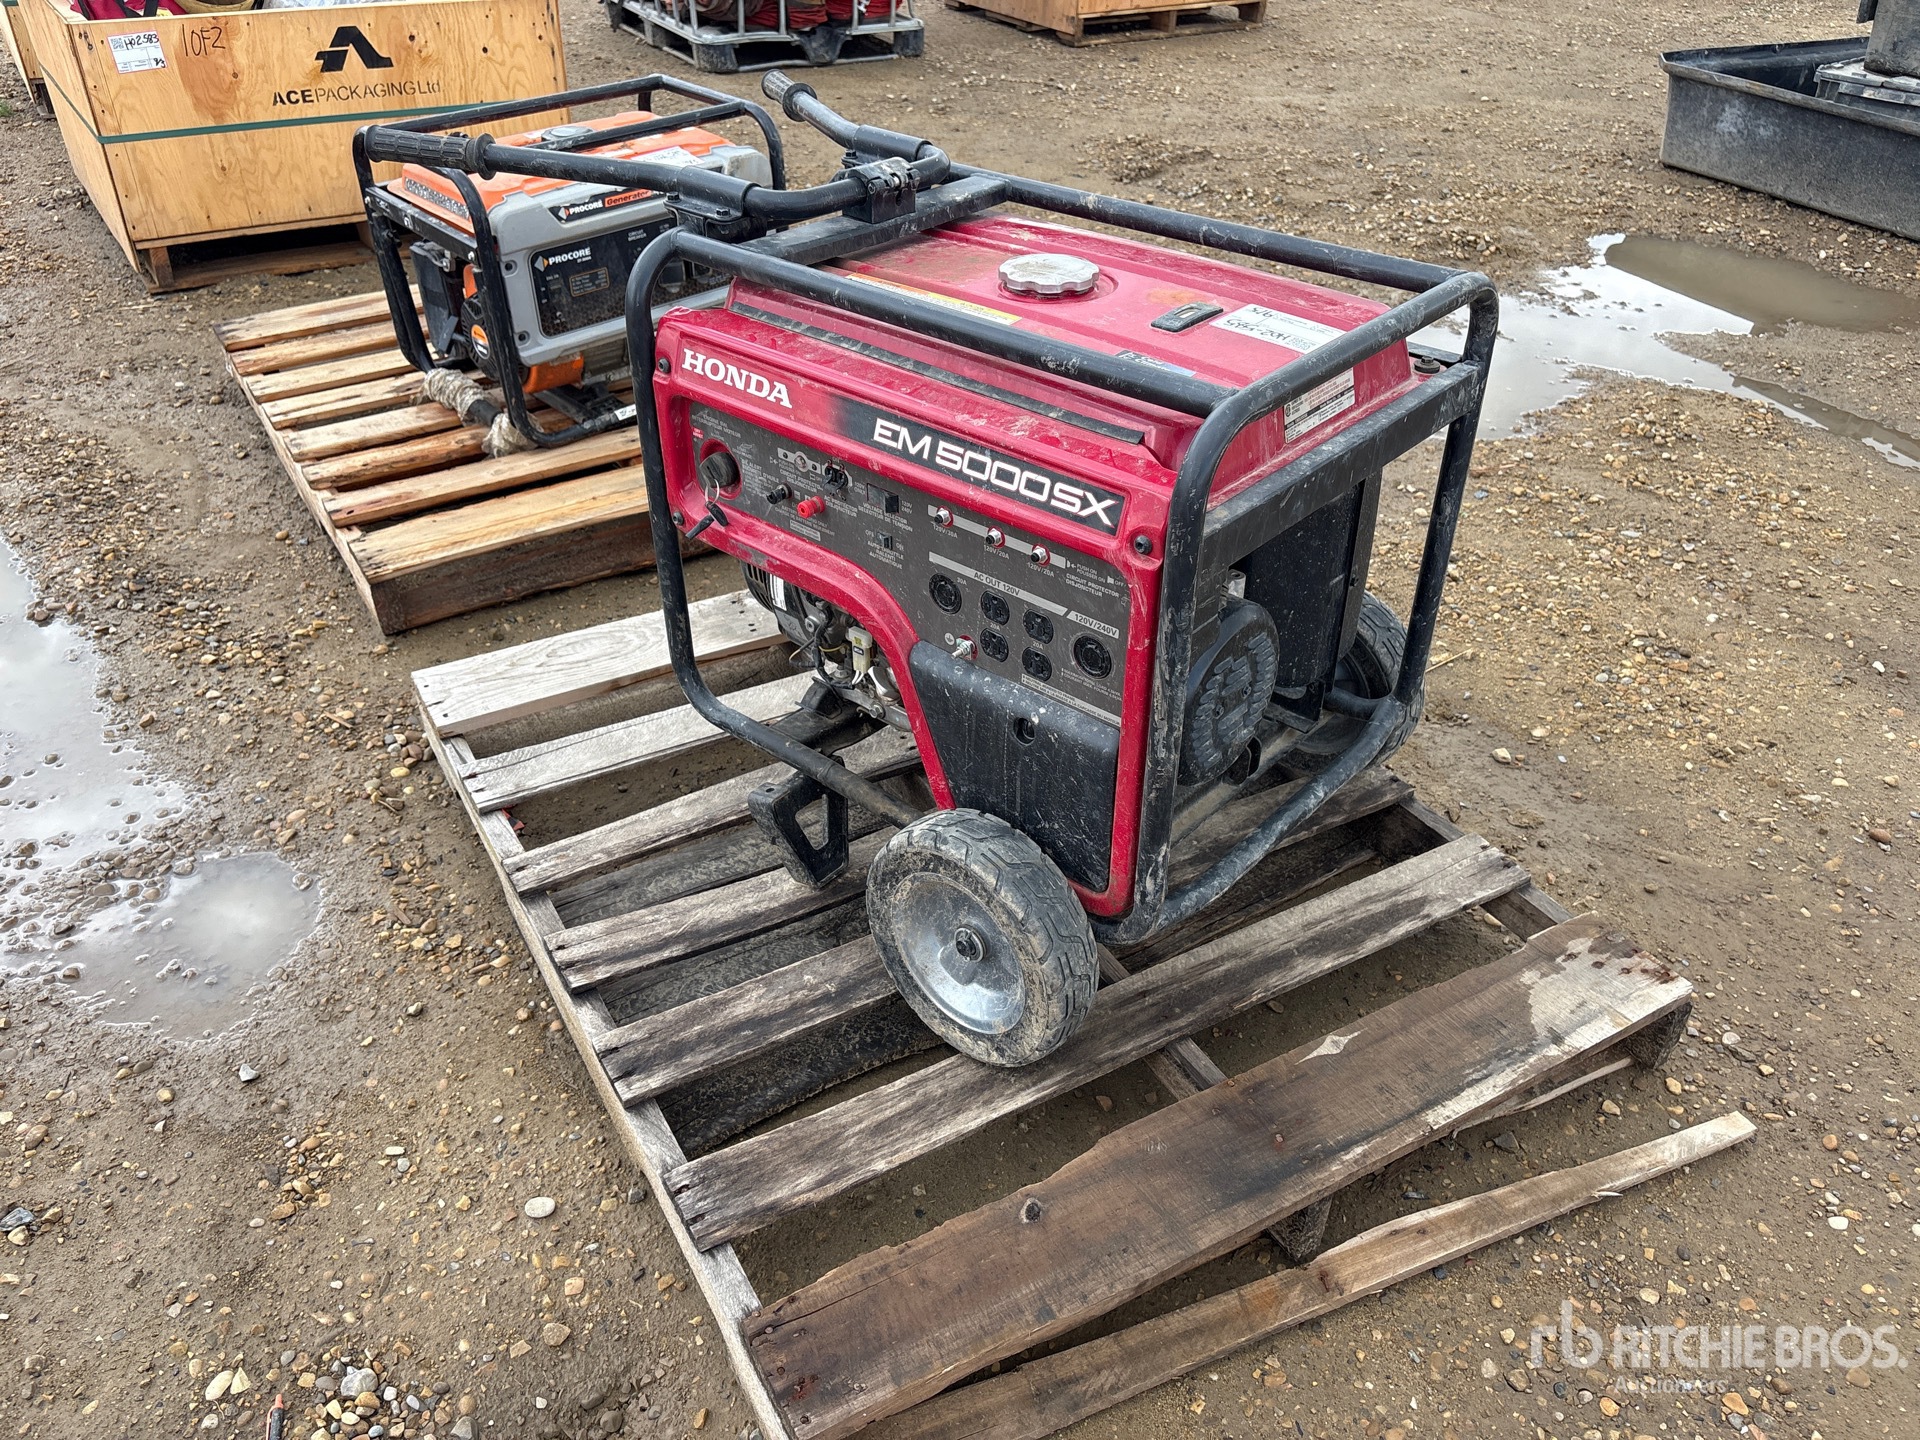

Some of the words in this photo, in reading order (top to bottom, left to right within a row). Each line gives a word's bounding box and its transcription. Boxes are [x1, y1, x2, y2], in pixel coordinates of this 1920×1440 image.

[569, 199, 603, 215] PROCORE
[549, 246, 591, 265] PROCORE
[681, 348, 793, 409] HONDA
[983, 545, 1010, 560] 120V/20A
[1027, 562, 1055, 577] 120V/20A
[1076, 563, 1090, 572] PUSH
[974, 571, 984, 581] AC
[985, 576, 1001, 588] OUT
[1002, 583, 1020, 596] 120V
[1065, 578, 1103, 598] DISJONCTEUR
[1066, 573, 1087, 585] CIRCUIT
[1087, 581, 1120, 598] PROTECTOR
[1074, 613, 1118, 636] 120V/240V
